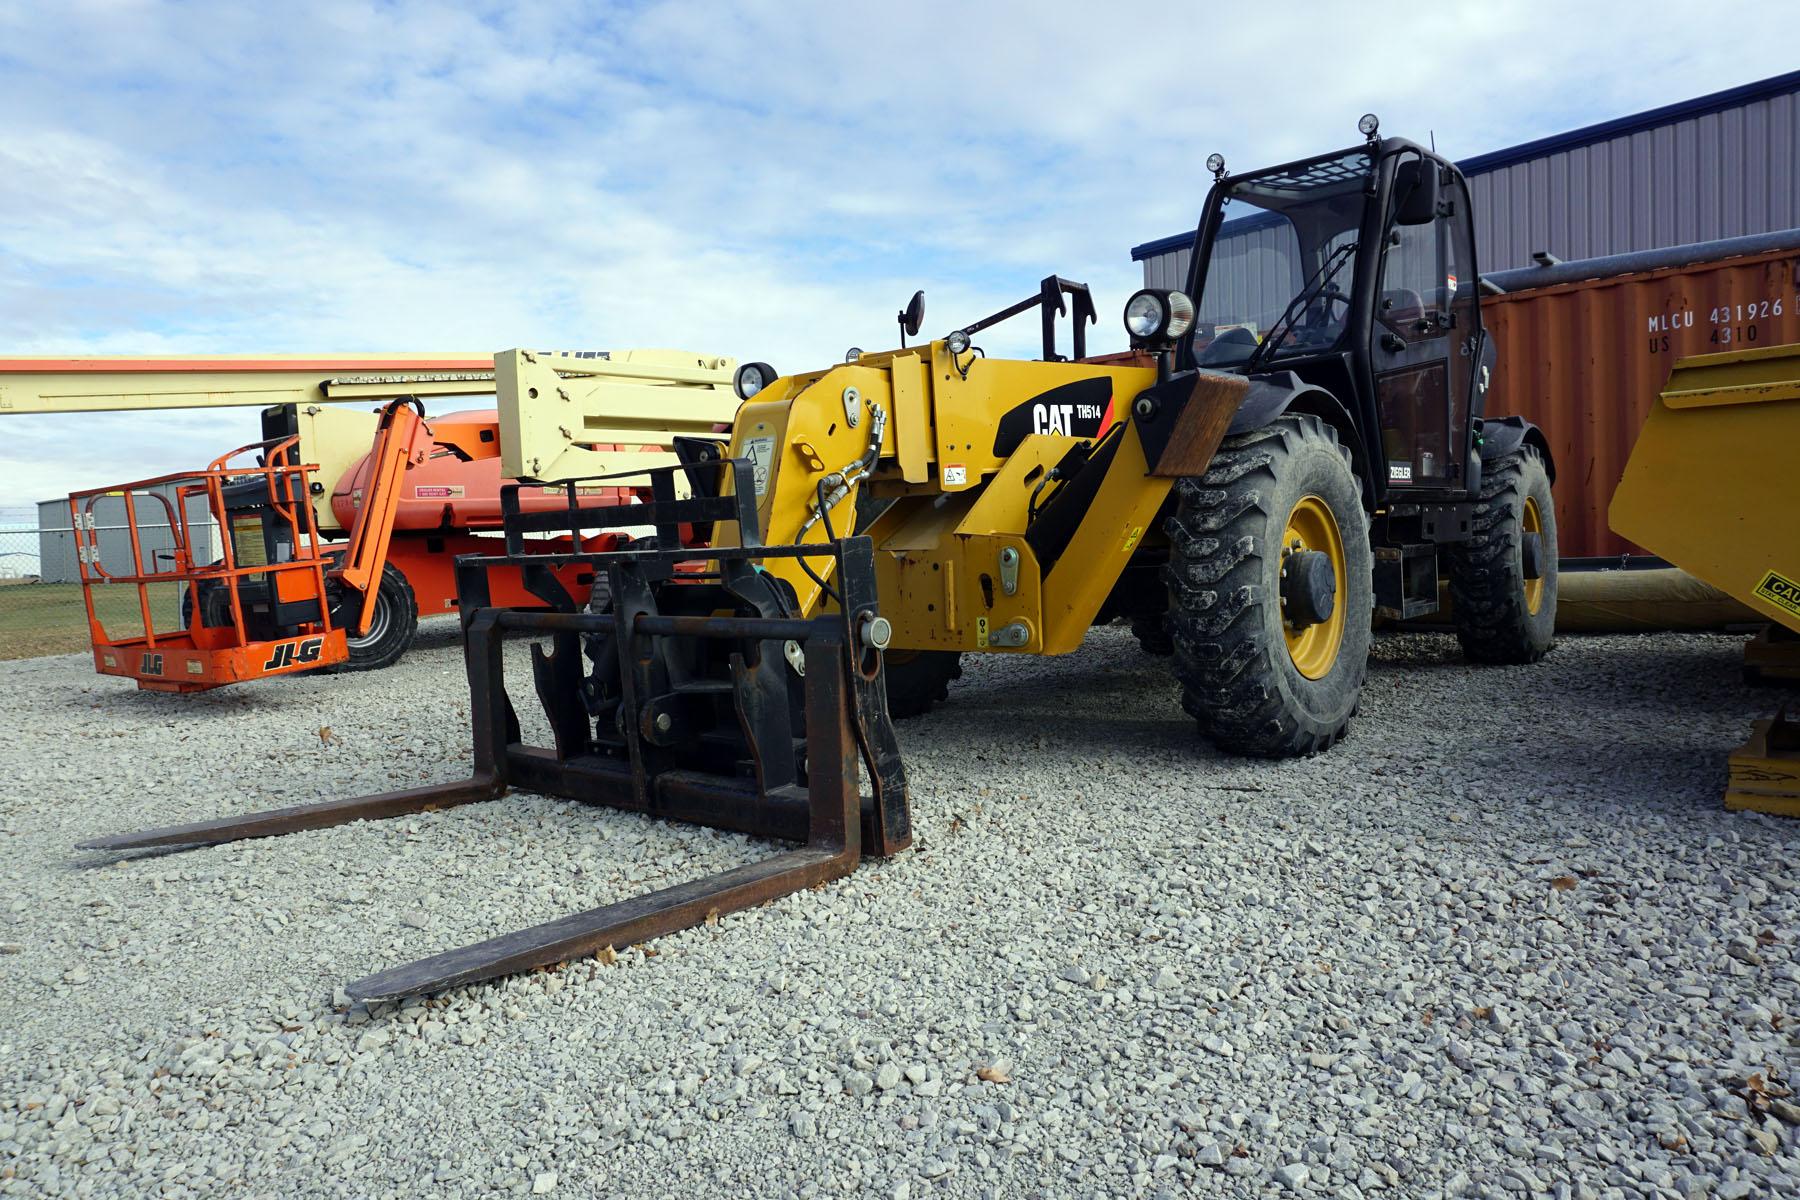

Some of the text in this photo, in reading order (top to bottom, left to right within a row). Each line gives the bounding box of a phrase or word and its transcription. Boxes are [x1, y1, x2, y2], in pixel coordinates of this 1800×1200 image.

[1649, 298, 1782, 332] MLCU 431926
[1649, 325, 1757, 353] US 4310
[1033, 403, 1101, 437] CAT TH514
[1390, 466, 1411, 479] ZIEGLER
[141, 653, 163, 676] JLG
[263, 637, 324, 672] JLG
